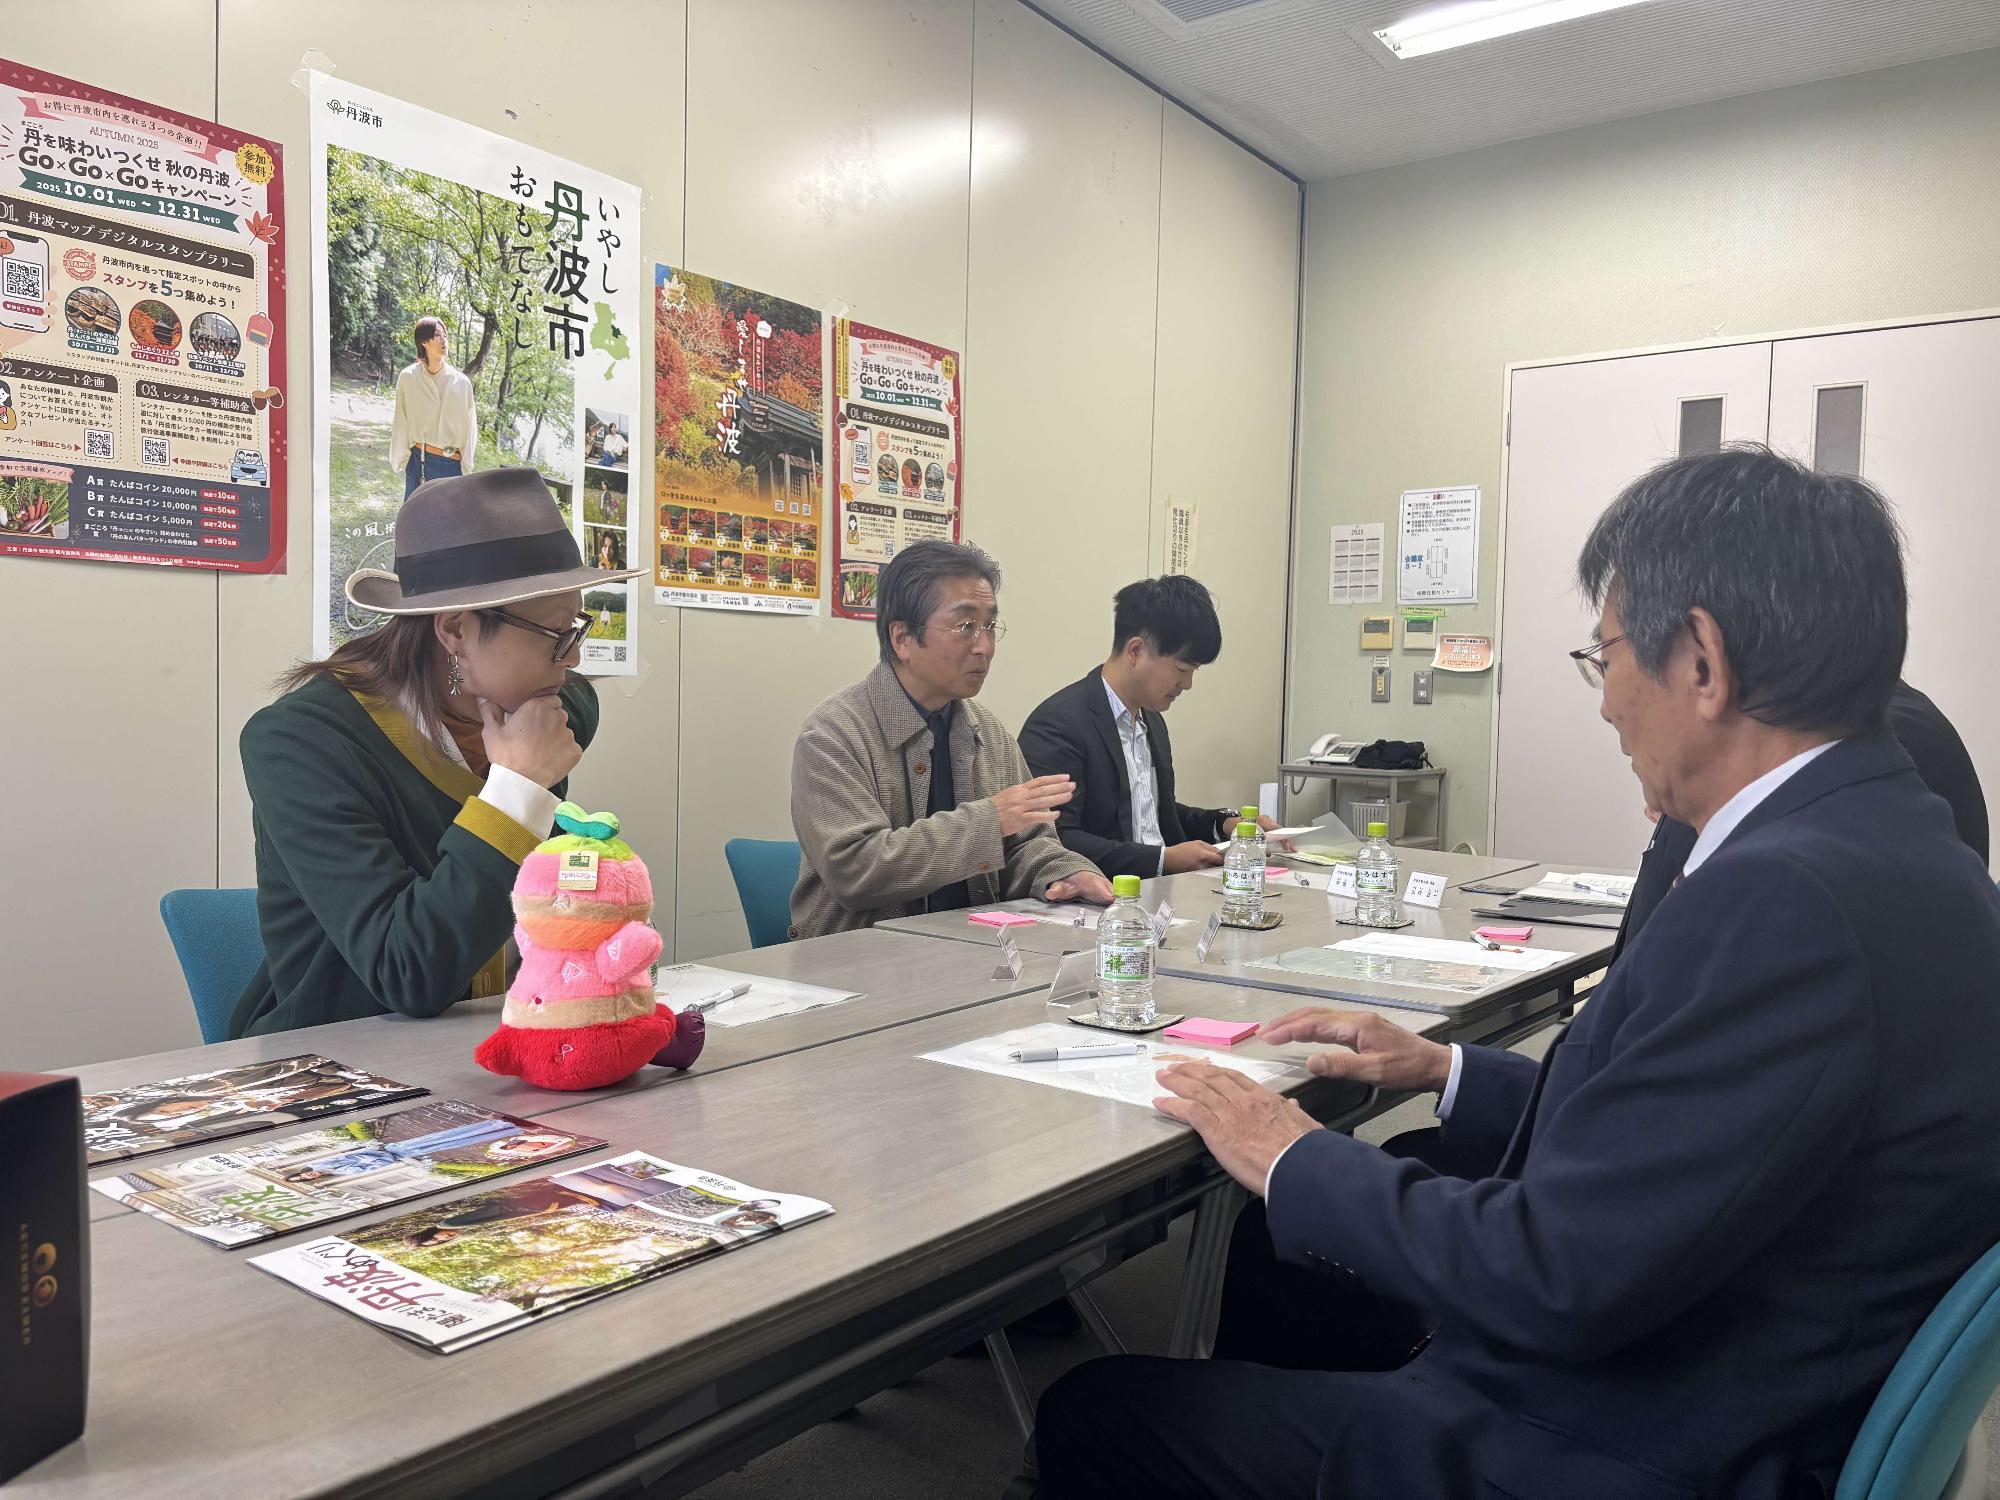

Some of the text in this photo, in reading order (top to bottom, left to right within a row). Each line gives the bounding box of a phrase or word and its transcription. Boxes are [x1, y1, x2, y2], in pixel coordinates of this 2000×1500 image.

[346, 106, 383, 128] 丹波市
[89, 126, 159, 150] AUTUMN 2025
[24, 127, 231, 188] 丹を味わいつくせ 秋の丹波
[243, 150, 266, 165] 参加
[244, 162, 267, 178] 無料
[117, 198, 137, 208] WED
[158, 201, 200, 221] 12.31
[202, 215, 221, 224] WED
[510, 165, 537, 349] おもてなし
[597, 196, 621, 294] いやし
[543, 180, 590, 360] 丹波市
[21, 367, 105, 388] アンケート企画
[140, 384, 250, 412] 03. レンタカー等補助金
[715, 386, 741, 455] 丹波
[87, 475, 104, 487] A賞
[109, 479, 160, 492] たんばコイン
[161, 485, 197, 497] 20,000円
[87, 491, 104, 502] B賞
[109, 495, 160, 508] たんばコイン
[162, 501, 197, 512] 10,000円
[87, 507, 105, 518] C賞
[110, 511, 160, 522] たんばコイン
[162, 516, 193, 526] 5,000円
[221, 1184, 343, 1222] 丹波
[306, 1242, 380, 1270] めぐり
[321, 1263, 446, 1310] 丹波
[391, 1302, 473, 1329] 陽だまり
